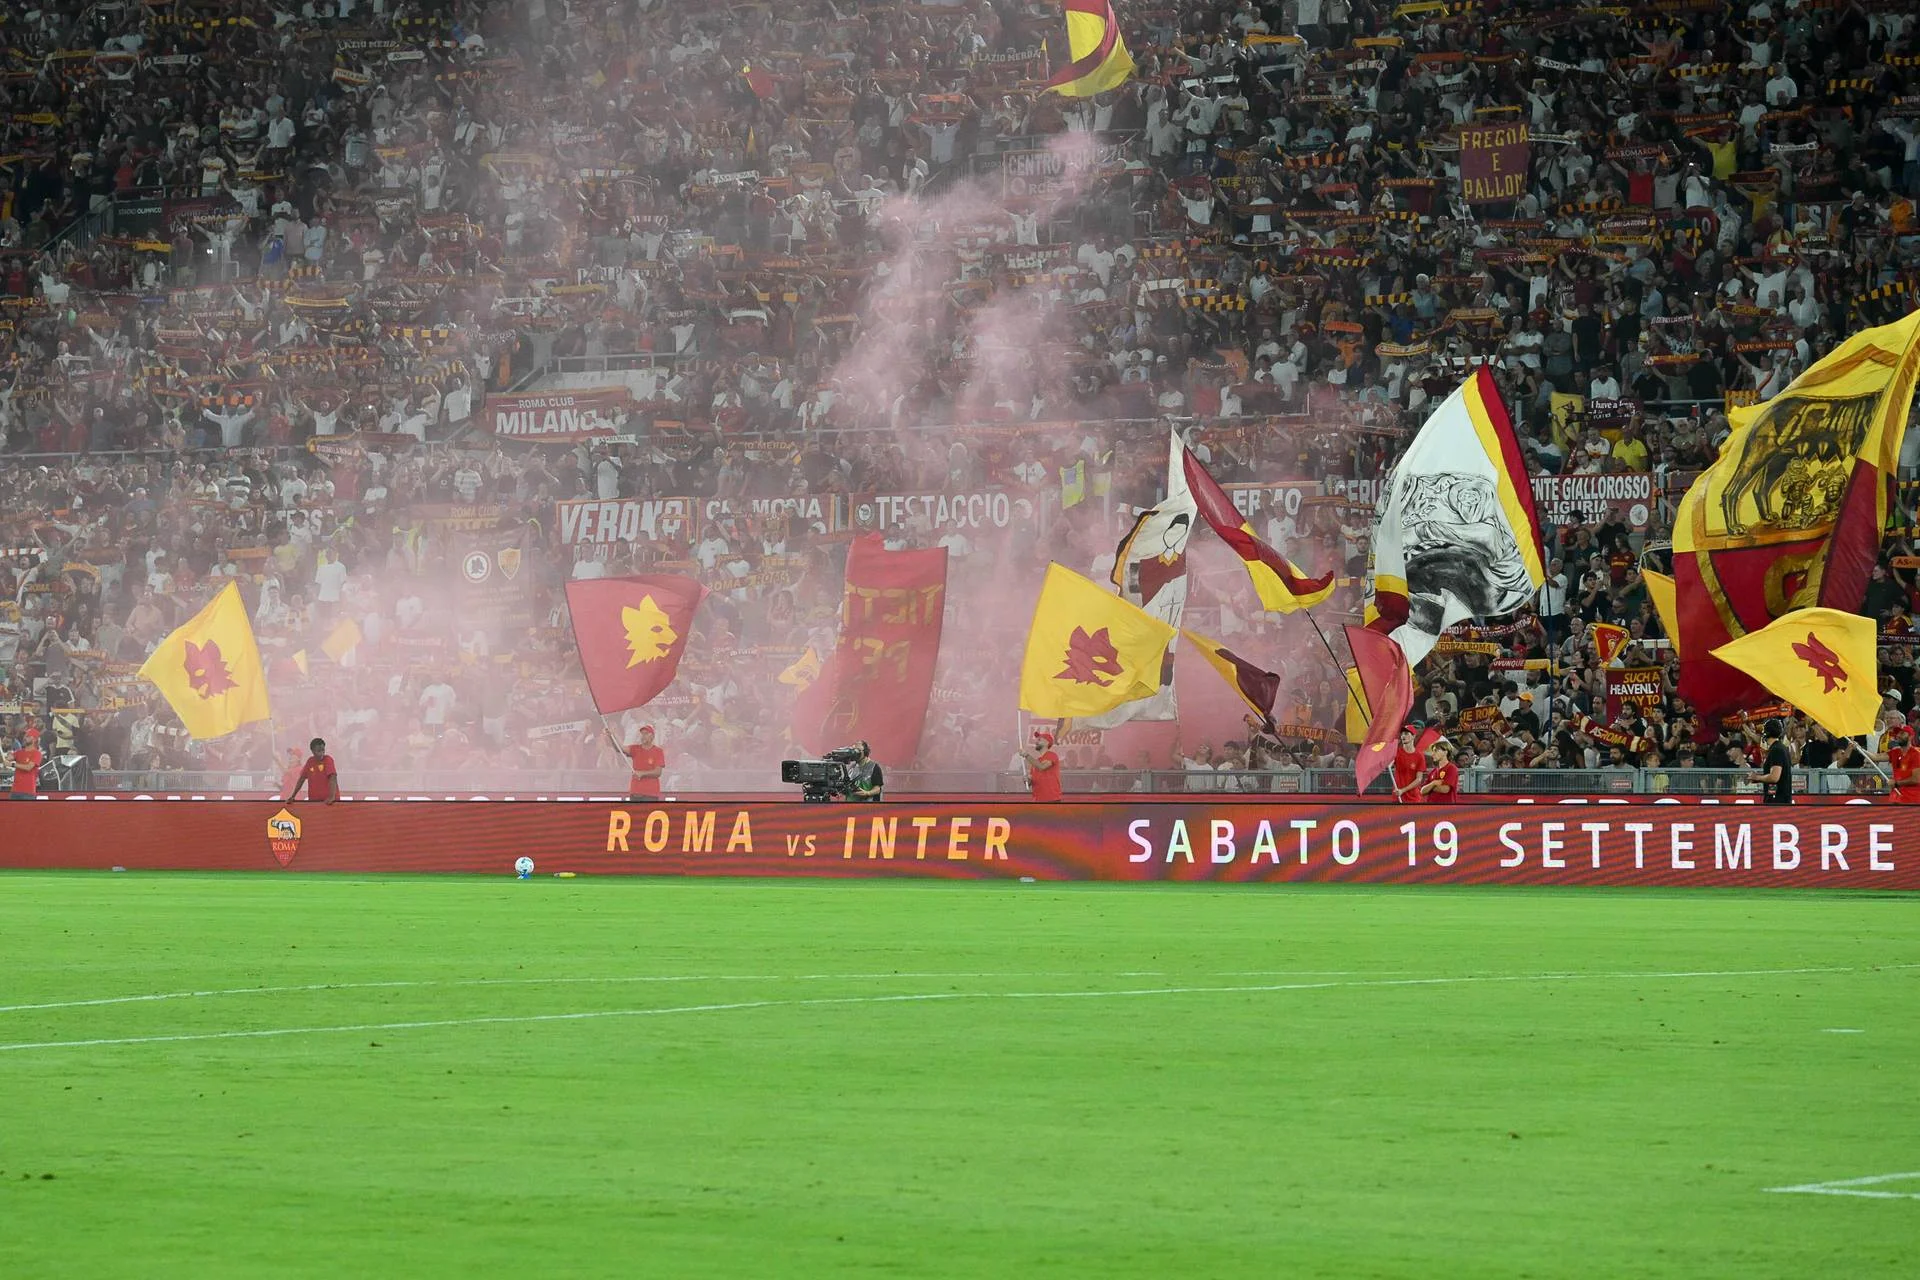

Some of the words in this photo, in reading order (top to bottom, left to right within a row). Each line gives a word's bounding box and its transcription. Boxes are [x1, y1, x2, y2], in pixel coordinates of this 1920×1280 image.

[979, 53, 1006, 62] LAZIO
[1007, 49, 1041, 61] MERDA
[1492, 153, 1501, 171] E
[518, 399, 547, 409] ROMA
[549, 397, 574, 407] CLUB
[496, 409, 598, 434] MILANO
[1562, 475, 1650, 500] GIALLOROSSO
[1545, 500, 1608, 514] LIGURIA
[1469, 643, 1491, 652] ROMA
[1623, 673, 1649, 684] SUCH
[1651, 672, 1661, 682] A
[1609, 683, 1661, 696] HEAVENLY
[1647, 695, 1661, 705] TO
[272, 842, 297, 851] ROMA
[607, 811, 753, 853] ROMA
[843, 816, 1011, 860] INTER
[1127, 818, 1360, 866] SABATO
[1400, 820, 1458, 867] 19
[1499, 821, 1896, 871] SETTEMBRE
